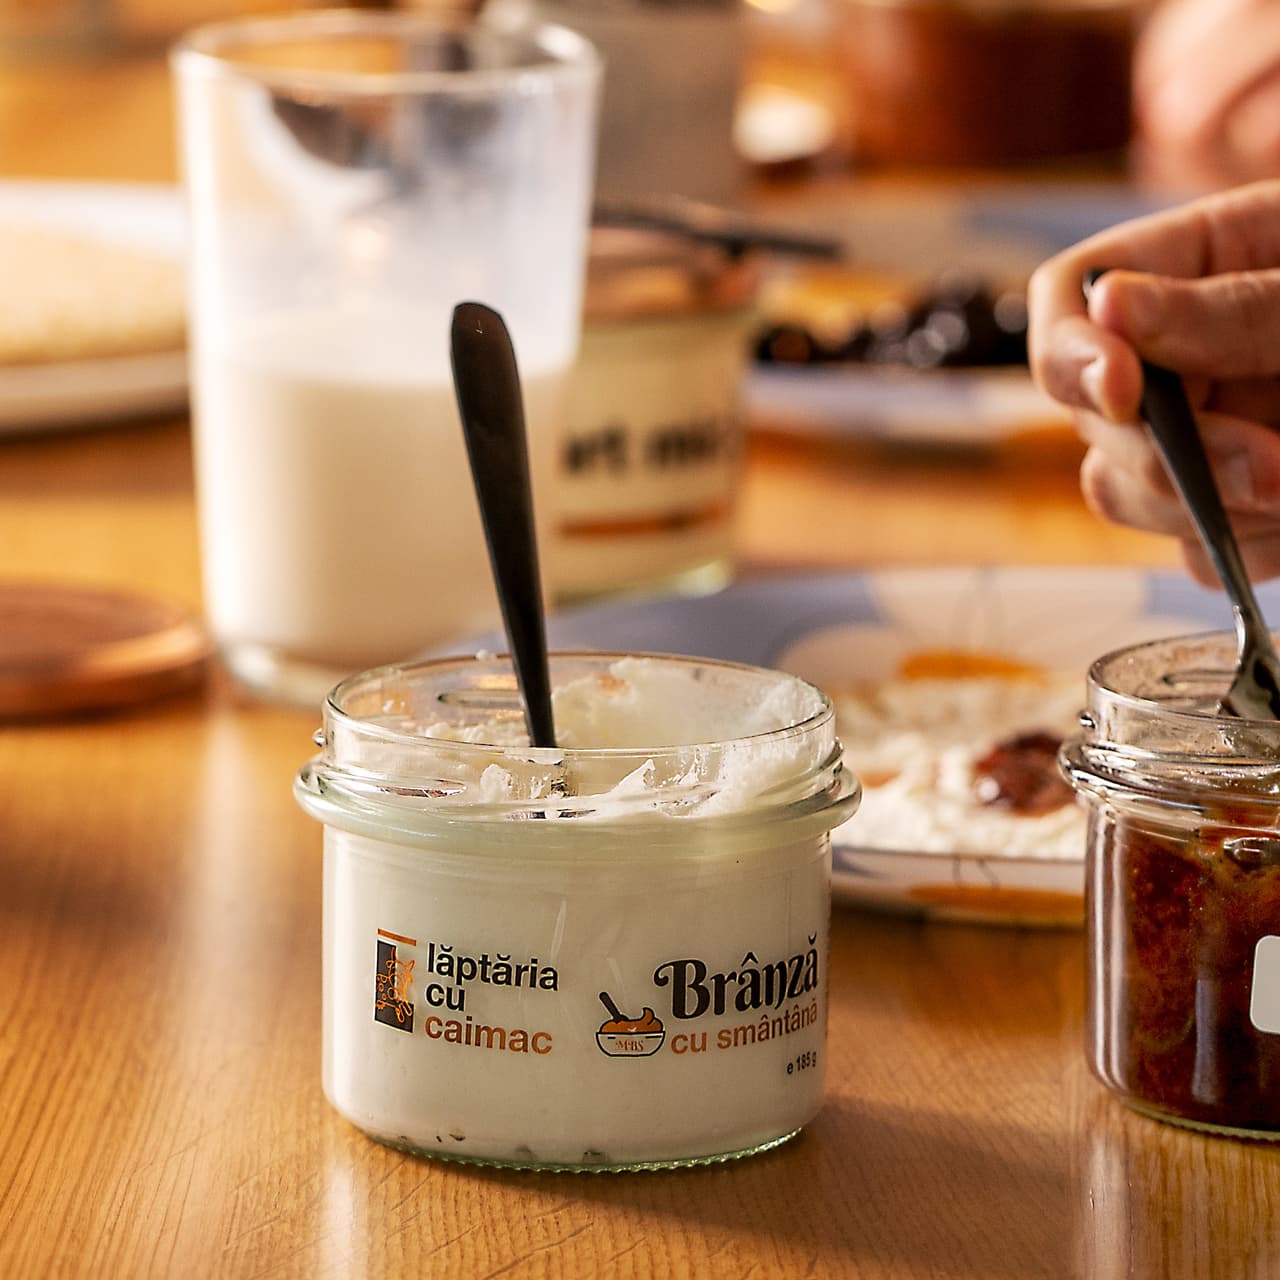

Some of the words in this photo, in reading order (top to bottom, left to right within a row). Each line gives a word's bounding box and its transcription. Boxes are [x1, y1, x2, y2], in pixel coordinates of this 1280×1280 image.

[427, 942, 559, 991] lăptăria
[653, 931, 818, 1019] Brânză
[426, 983, 465, 1011] cu
[425, 1016, 552, 1054] caimac
[671, 1032, 707, 1054] cu
[717, 998, 817, 1050] smântână
[797, 1052, 811, 1071] 185
